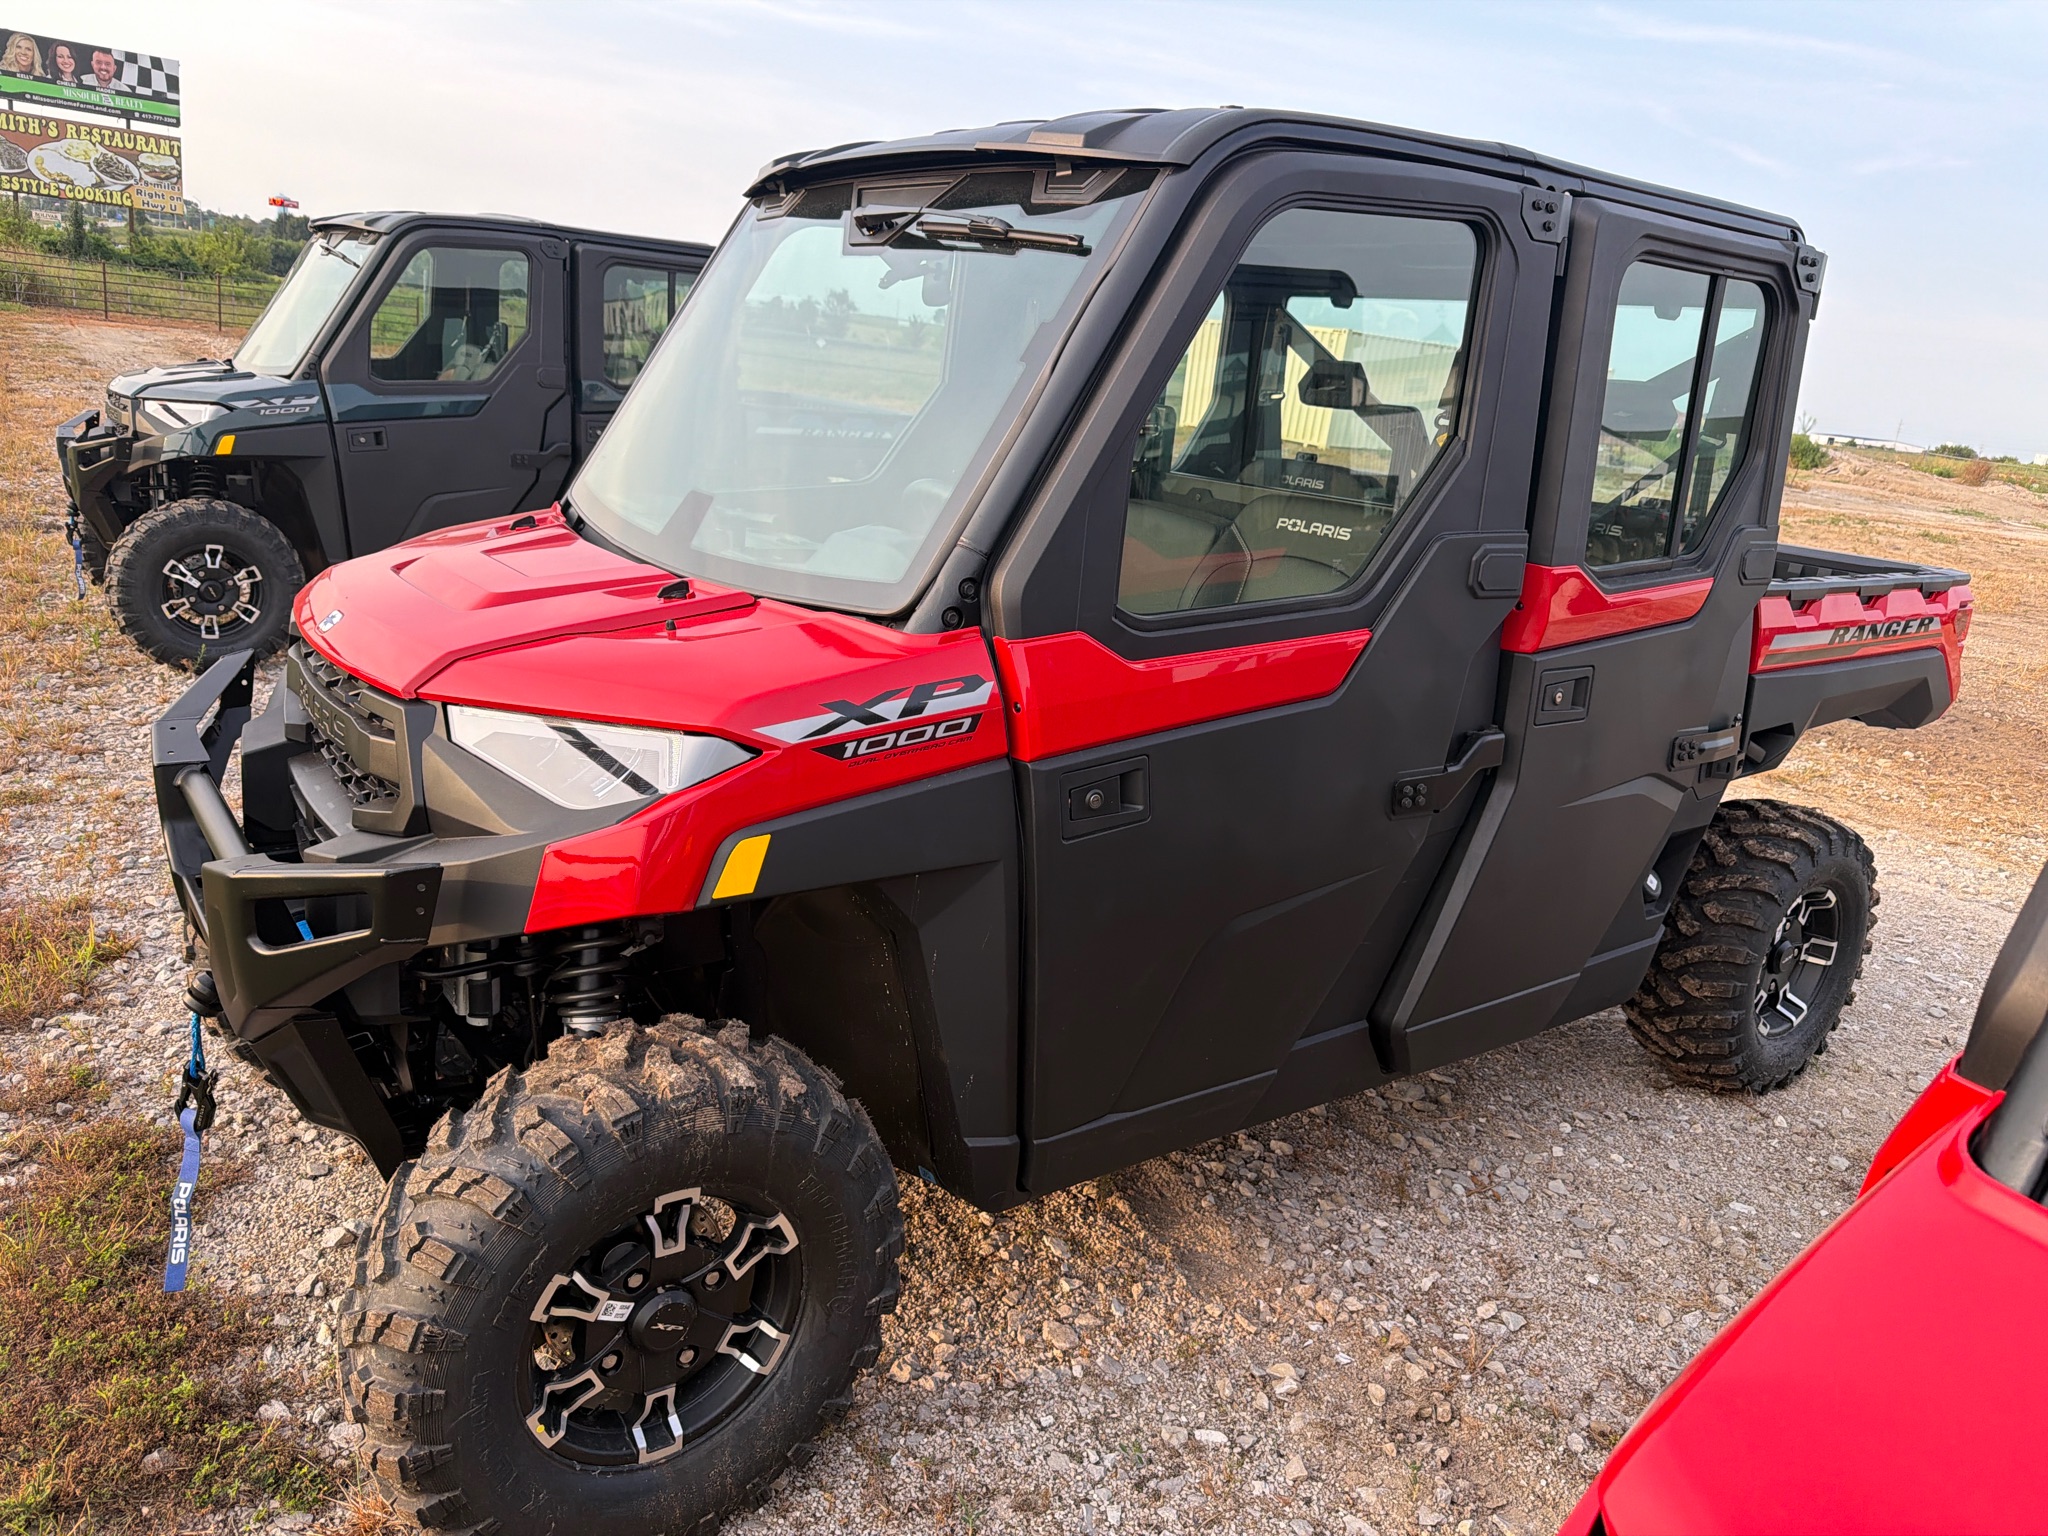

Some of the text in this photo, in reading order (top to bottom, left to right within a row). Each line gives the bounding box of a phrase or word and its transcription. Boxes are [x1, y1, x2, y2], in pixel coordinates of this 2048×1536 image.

[63, 87, 100, 102] MISSOURI
[115, 97, 143, 109] REALTY
[65, 123, 181, 157] RESTAURANT
[0, 174, 133, 207] ESTYLE COOKING
[136, 188, 166, 200] Right
[142, 200, 177, 212] Hwy U
[260, 406, 310, 415] 1000
[1275, 517, 1352, 541] POLARIS
[1827, 616, 1935, 646] RANGER
[797, 673, 988, 740] XP
[843, 716, 972, 759] 1000
[848, 735, 973, 768] DUAL OVERHEAD CAM
[170, 1181, 193, 1265] POLARIS
